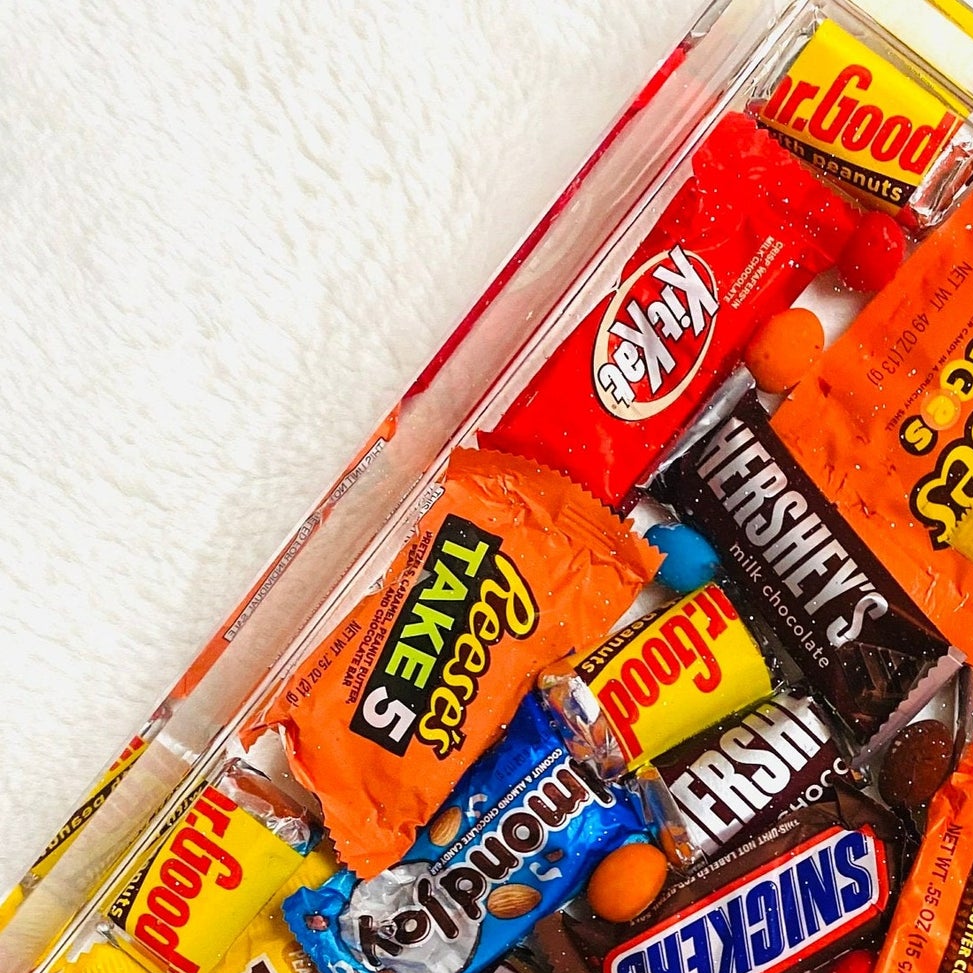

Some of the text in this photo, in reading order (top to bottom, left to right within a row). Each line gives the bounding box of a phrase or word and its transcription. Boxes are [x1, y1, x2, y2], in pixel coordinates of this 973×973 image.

[764, 64, 963, 176] r.Good
[808, 152, 905, 202] peanuts
[722, 234, 775, 303] MILK CHOCOLATE
[730, 240, 784, 309] CRISP WAFERS IN
[945, 259, 973, 289] NET
[895, 329, 919, 354] OZ
[944, 326, 969, 355] CANDY
[883, 408, 906, 433] SHELL
[697, 417, 888, 649] HERSHEY'S
[729, 543, 830, 669] milk chocolate
[339, 617, 363, 643] NET
[340, 586, 396, 687] AND CHOCOLATE BAR
[361, 538, 490, 743] TAKE 5
[328, 636, 348, 657] WT
[363, 626, 388, 666] PEANUT
[415, 550, 540, 760] Reese's
[306, 666, 327, 686] OZ
[596, 584, 738, 759] r.Good
[529, 747, 564, 779] COCONUT
[495, 779, 528, 809] ALMOND
[524, 775, 533, 784] &
[457, 806, 501, 844] CHOCOLATE
[938, 822, 963, 855] NET
[438, 841, 463, 865] CANDY
[735, 839, 757, 856] NOT
[930, 855, 952, 881] WT
[922, 880, 943, 906] .55
[914, 907, 936, 932] OZ
[900, 931, 926, 962] (15
